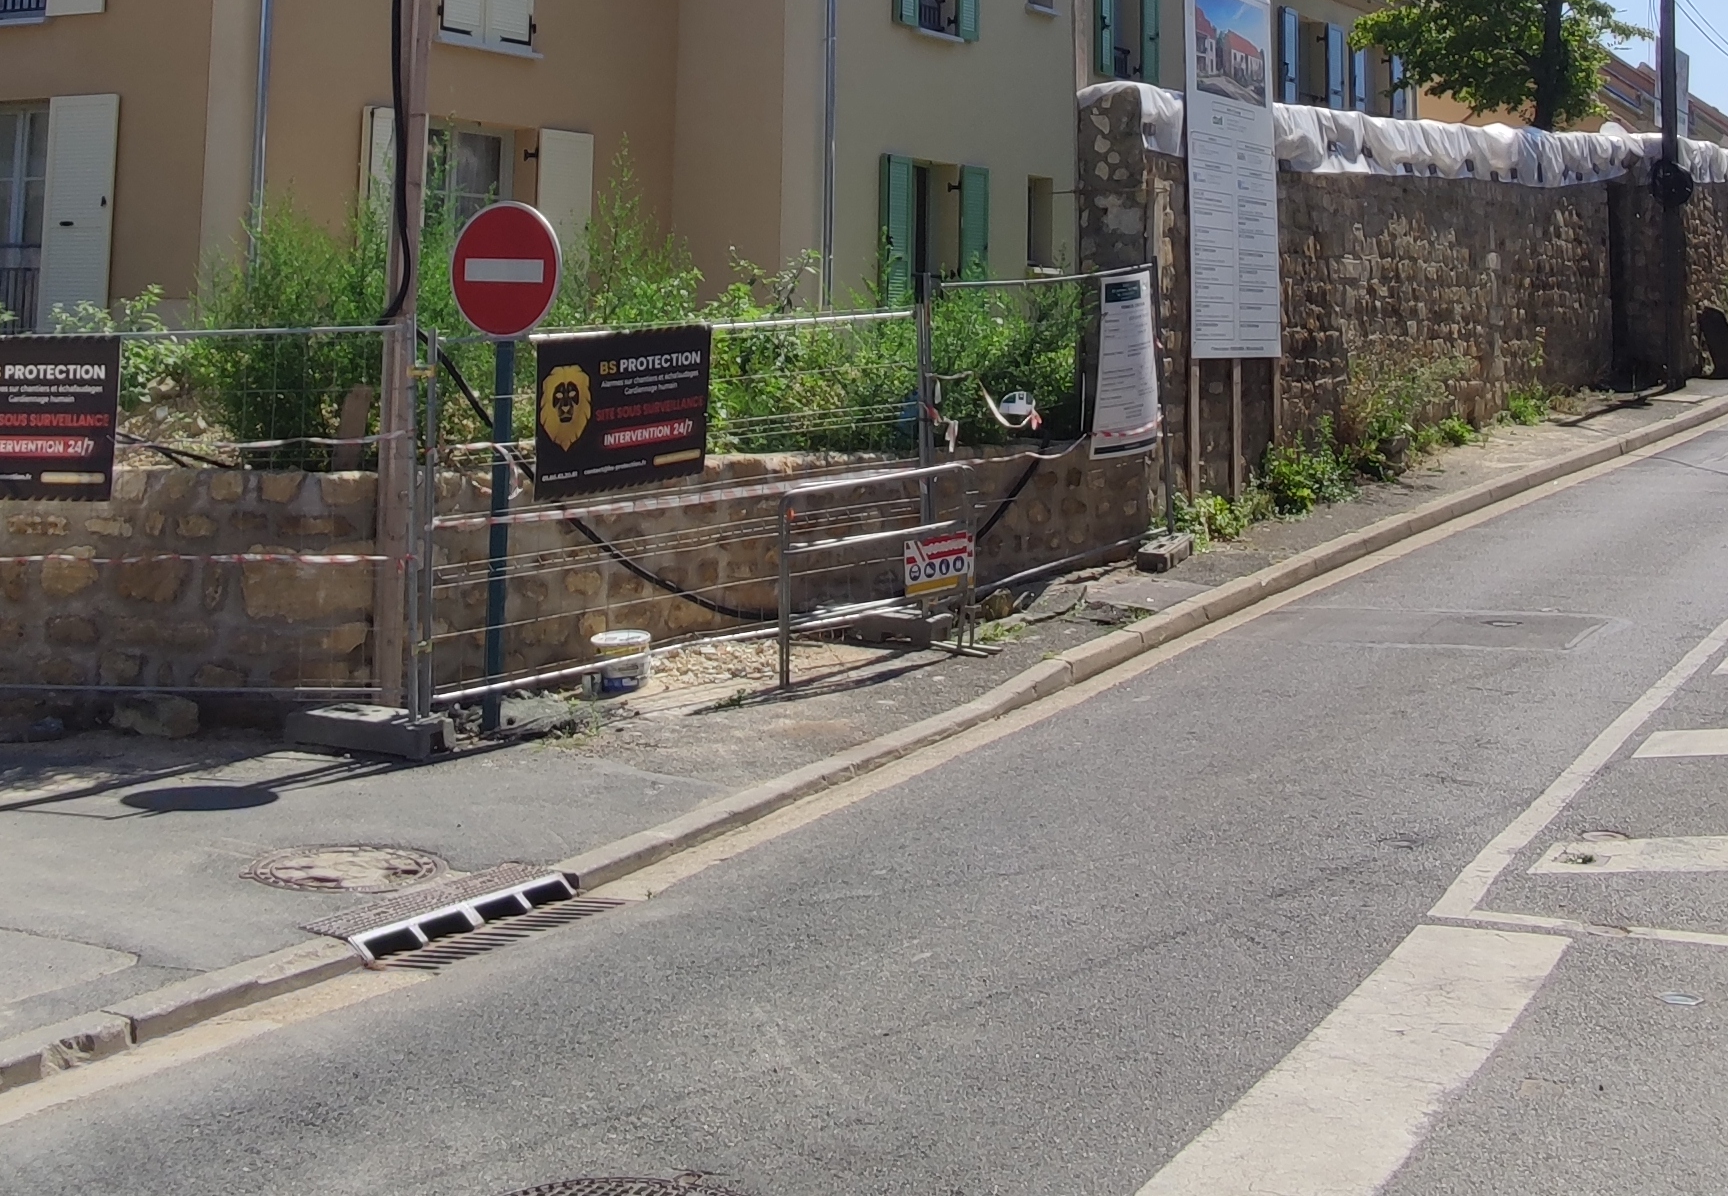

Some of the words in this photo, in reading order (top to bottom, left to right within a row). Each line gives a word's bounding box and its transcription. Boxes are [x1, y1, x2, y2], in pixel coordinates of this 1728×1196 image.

[4, 364, 106, 380] PROTECTION
[599, 360, 617, 375] BS
[620, 350, 701, 374] PROTECTION
[30, 413, 110, 427] SURVEILLANCE
[595, 409, 615, 422] SITE
[617, 405, 642, 419] SOUS
[643, 396, 705, 415] SURVEILLANCE
[603, 425, 671, 446] INTERVENTION
[673, 419, 693, 437] 24/7
[67, 437, 94, 456] 24/7
